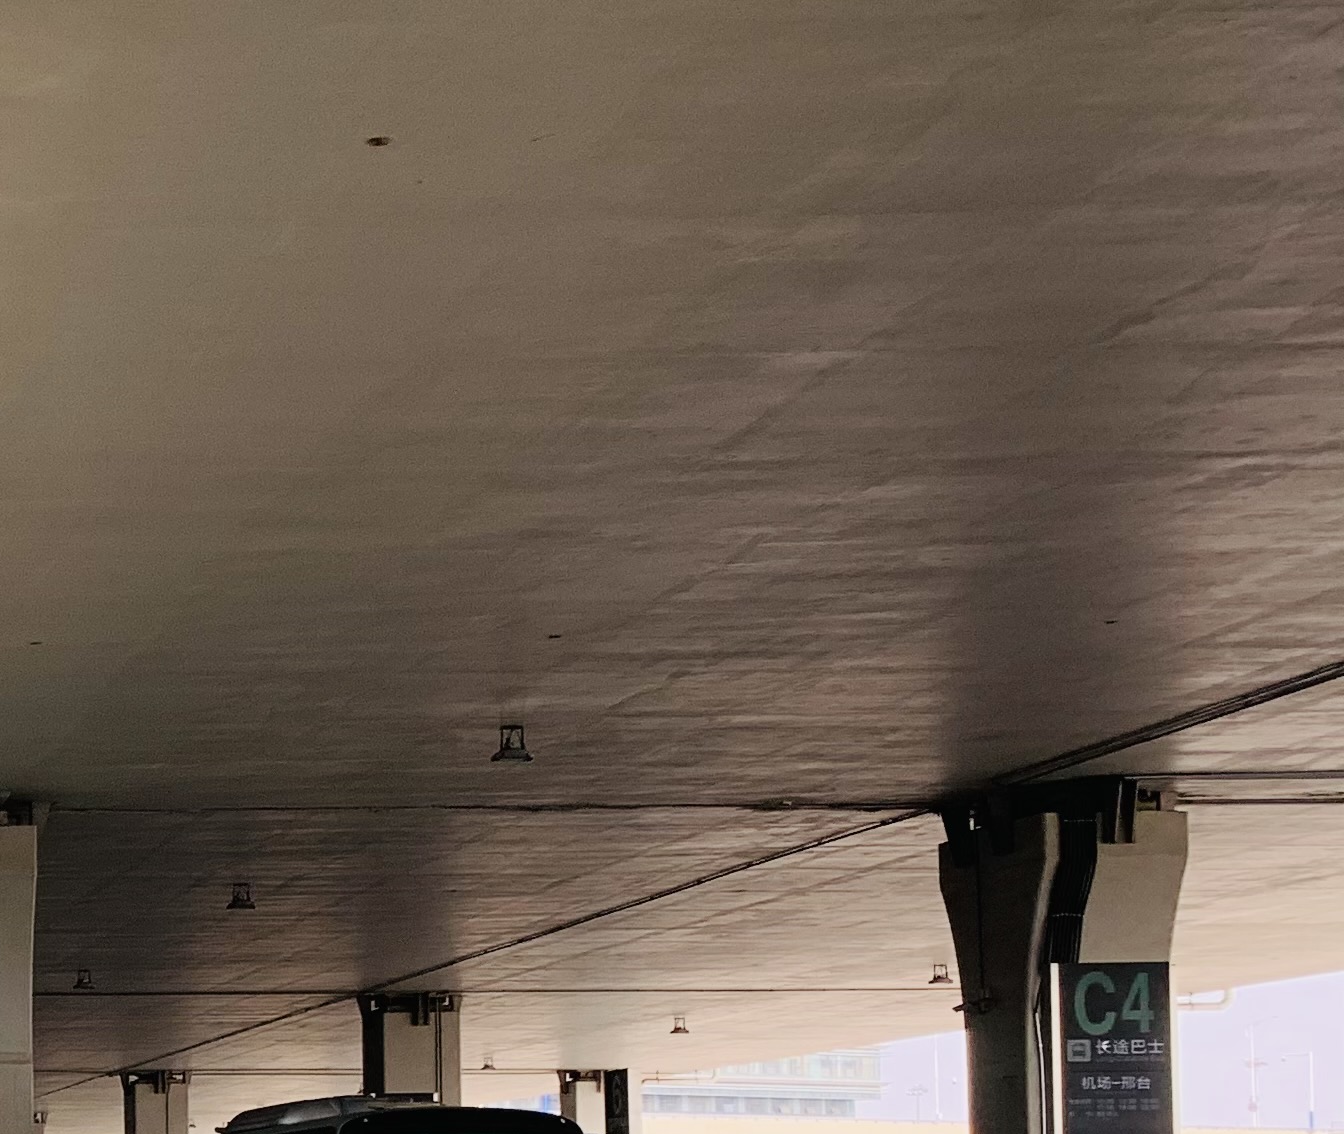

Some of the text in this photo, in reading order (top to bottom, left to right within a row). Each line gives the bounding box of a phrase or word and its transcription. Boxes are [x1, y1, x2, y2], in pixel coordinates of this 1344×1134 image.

[1074, 971, 1155, 1036] C4
[1095, 1039, 1165, 1055] 长途巴士
